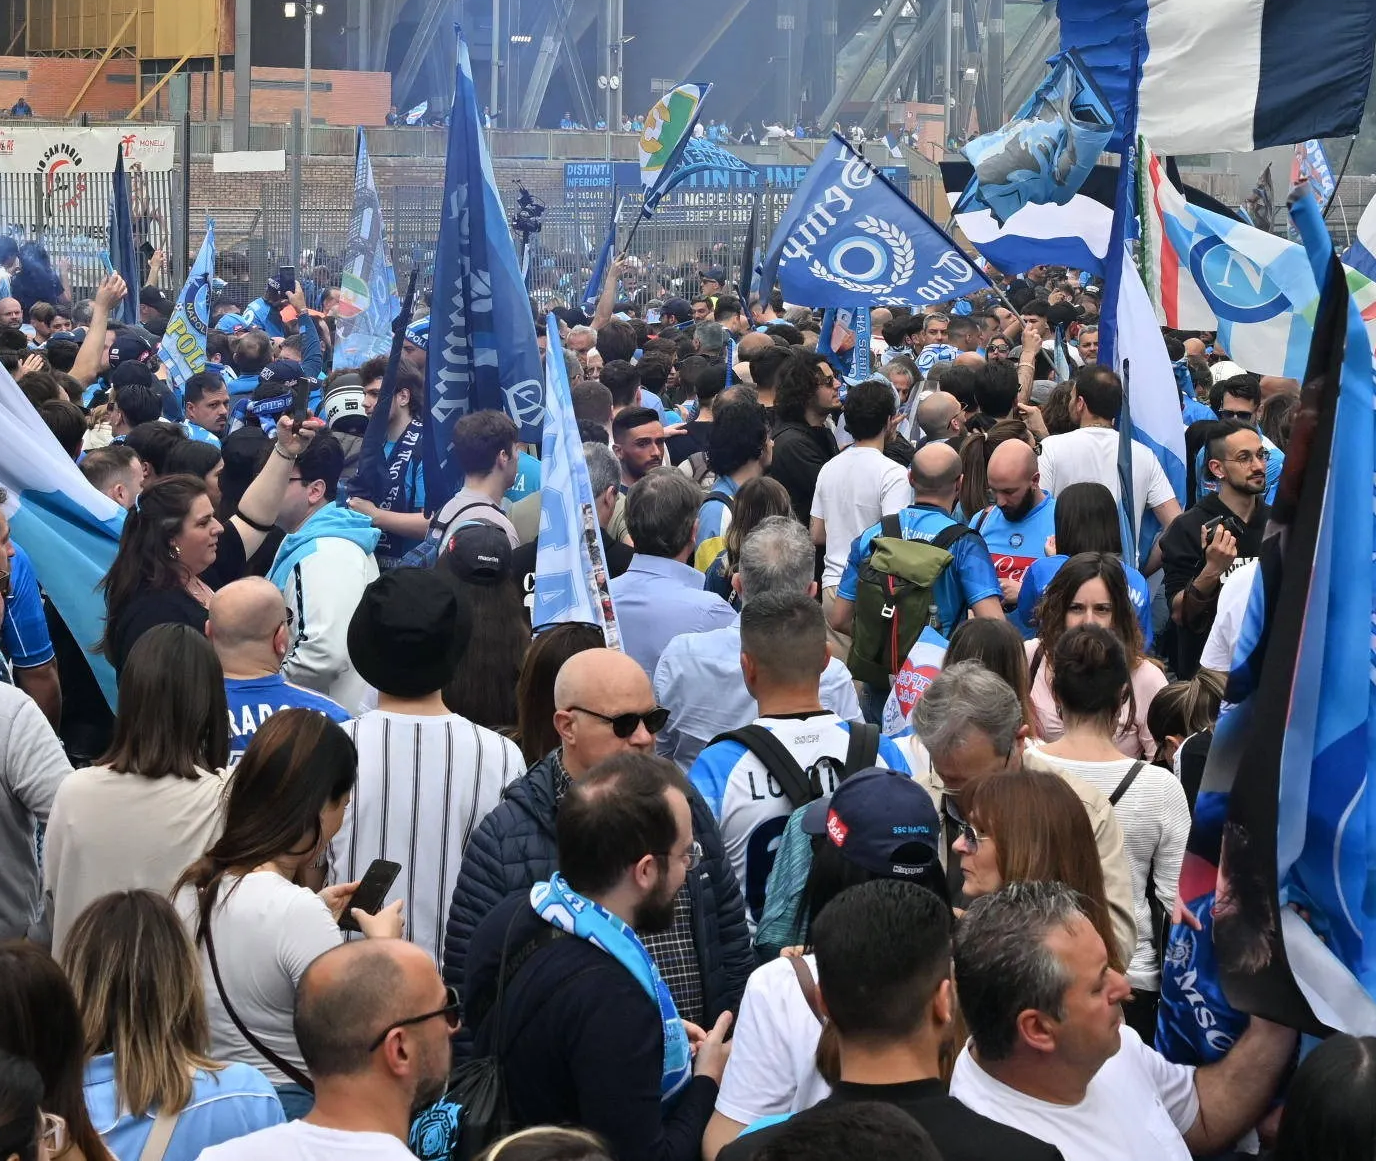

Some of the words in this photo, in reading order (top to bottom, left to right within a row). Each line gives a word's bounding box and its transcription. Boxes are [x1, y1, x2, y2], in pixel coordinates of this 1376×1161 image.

[44, 143, 60, 161] SAN
[60, 143, 82, 167] PAOLO
[567, 164, 610, 176] DISTINTI
[566, 177, 611, 187] INFERIORE
[893, 826, 907, 834] SSC
[908, 826, 930, 834] NAPOLI
[1174, 967, 1235, 1052] MSC
